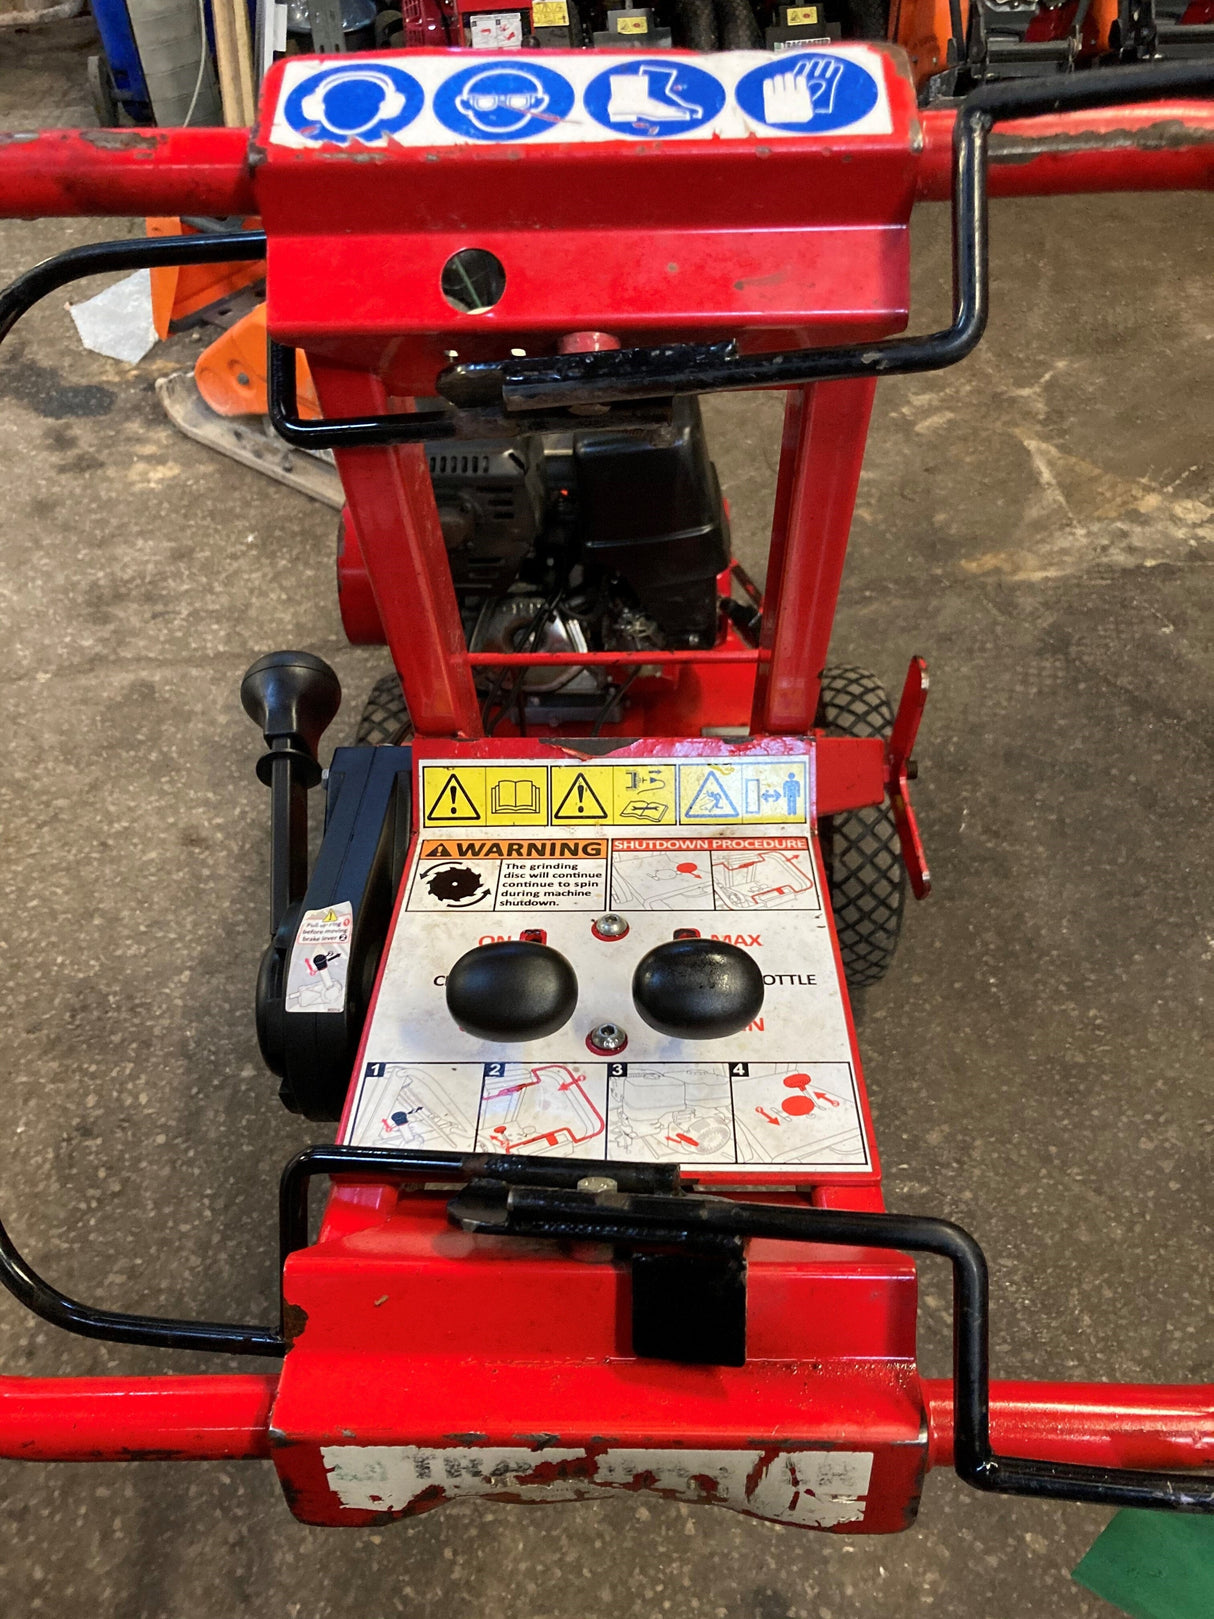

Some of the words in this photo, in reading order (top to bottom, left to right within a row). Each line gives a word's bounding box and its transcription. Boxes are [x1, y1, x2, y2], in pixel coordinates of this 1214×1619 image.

[456, 842, 602, 857] WARNING
[614, 839, 708, 850] SHUTDOWN
[712, 838, 806, 849] PROCEDURE
[529, 863, 578, 871] grinding
[529, 871, 549, 879] will
[574, 880, 599, 889] spin
[501, 890, 540, 898] during
[711, 934, 764, 947] MAX
[762, 974, 817, 985] OTTLE
[371, 1065, 381, 1076] 1
[489, 1063, 500, 1075] 2
[612, 1064, 623, 1075] 3
[733, 1064, 745, 1075] 4
